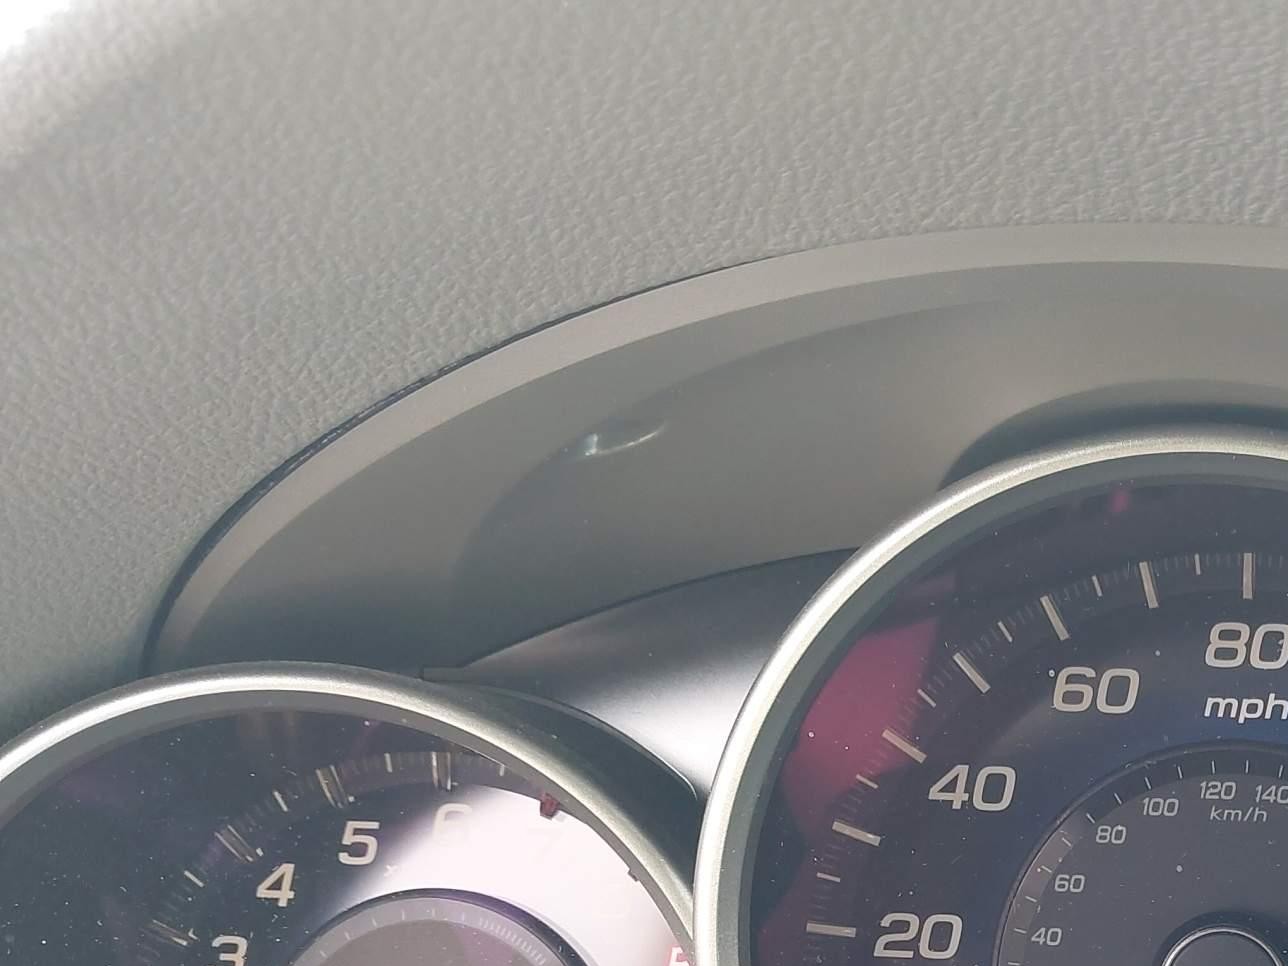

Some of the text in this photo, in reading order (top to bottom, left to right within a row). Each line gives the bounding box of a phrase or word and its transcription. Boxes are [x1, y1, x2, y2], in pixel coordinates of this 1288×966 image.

[1051, 666, 1140, 714] 60
[928, 764, 1016, 811] 40
[1200, 781, 1237, 800] 120
[1143, 797, 1179, 817] 100
[1209, 805, 1267, 822] km/h
[338, 820, 380, 865] 5
[1095, 824, 1127, 844] 80
[256, 863, 295, 907] 4
[1054, 874, 1085, 893] 60
[873, 912, 963, 960] 20
[1031, 927, 1062, 946] 40
